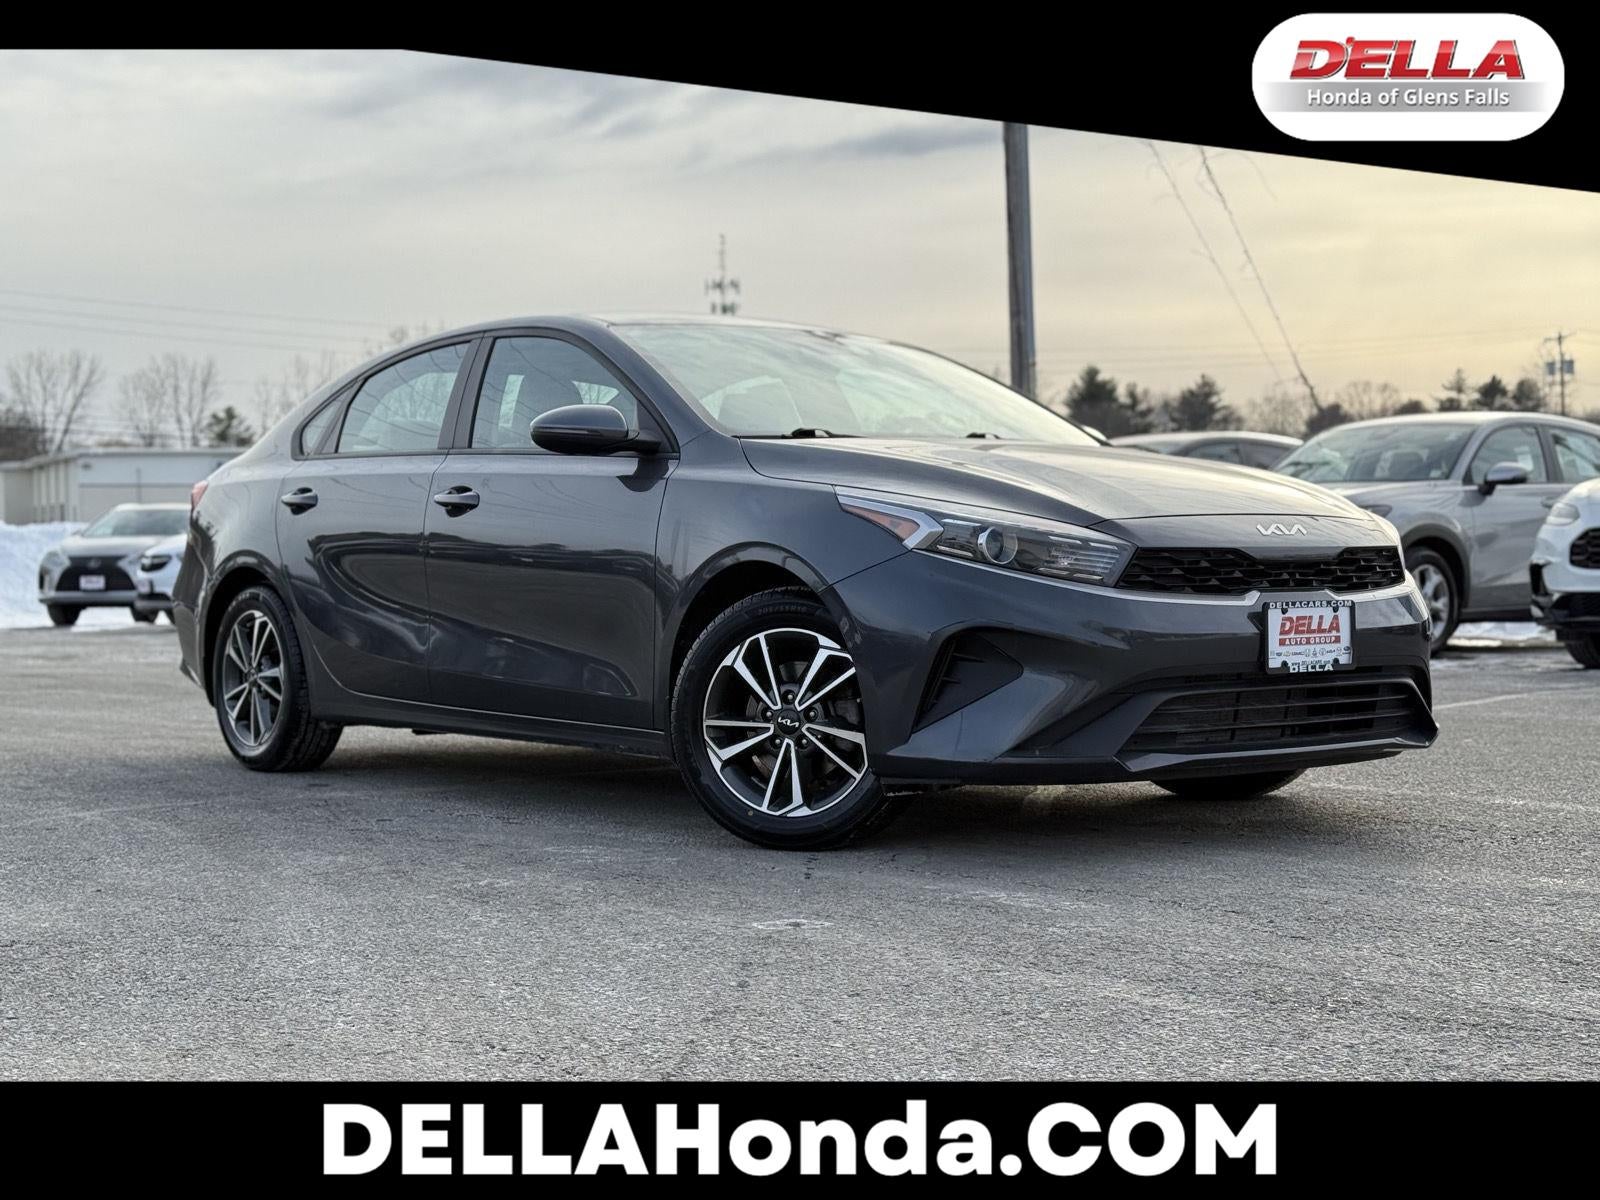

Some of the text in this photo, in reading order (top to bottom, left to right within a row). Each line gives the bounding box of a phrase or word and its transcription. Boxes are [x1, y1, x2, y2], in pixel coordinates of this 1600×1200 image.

[1269, 600, 1353, 609] DELLACARS.COM
[1279, 614, 1341, 636] DELLA
[1285, 636, 1336, 645] AUTO GROUP
[1289, 663, 1335, 673] DELLA
